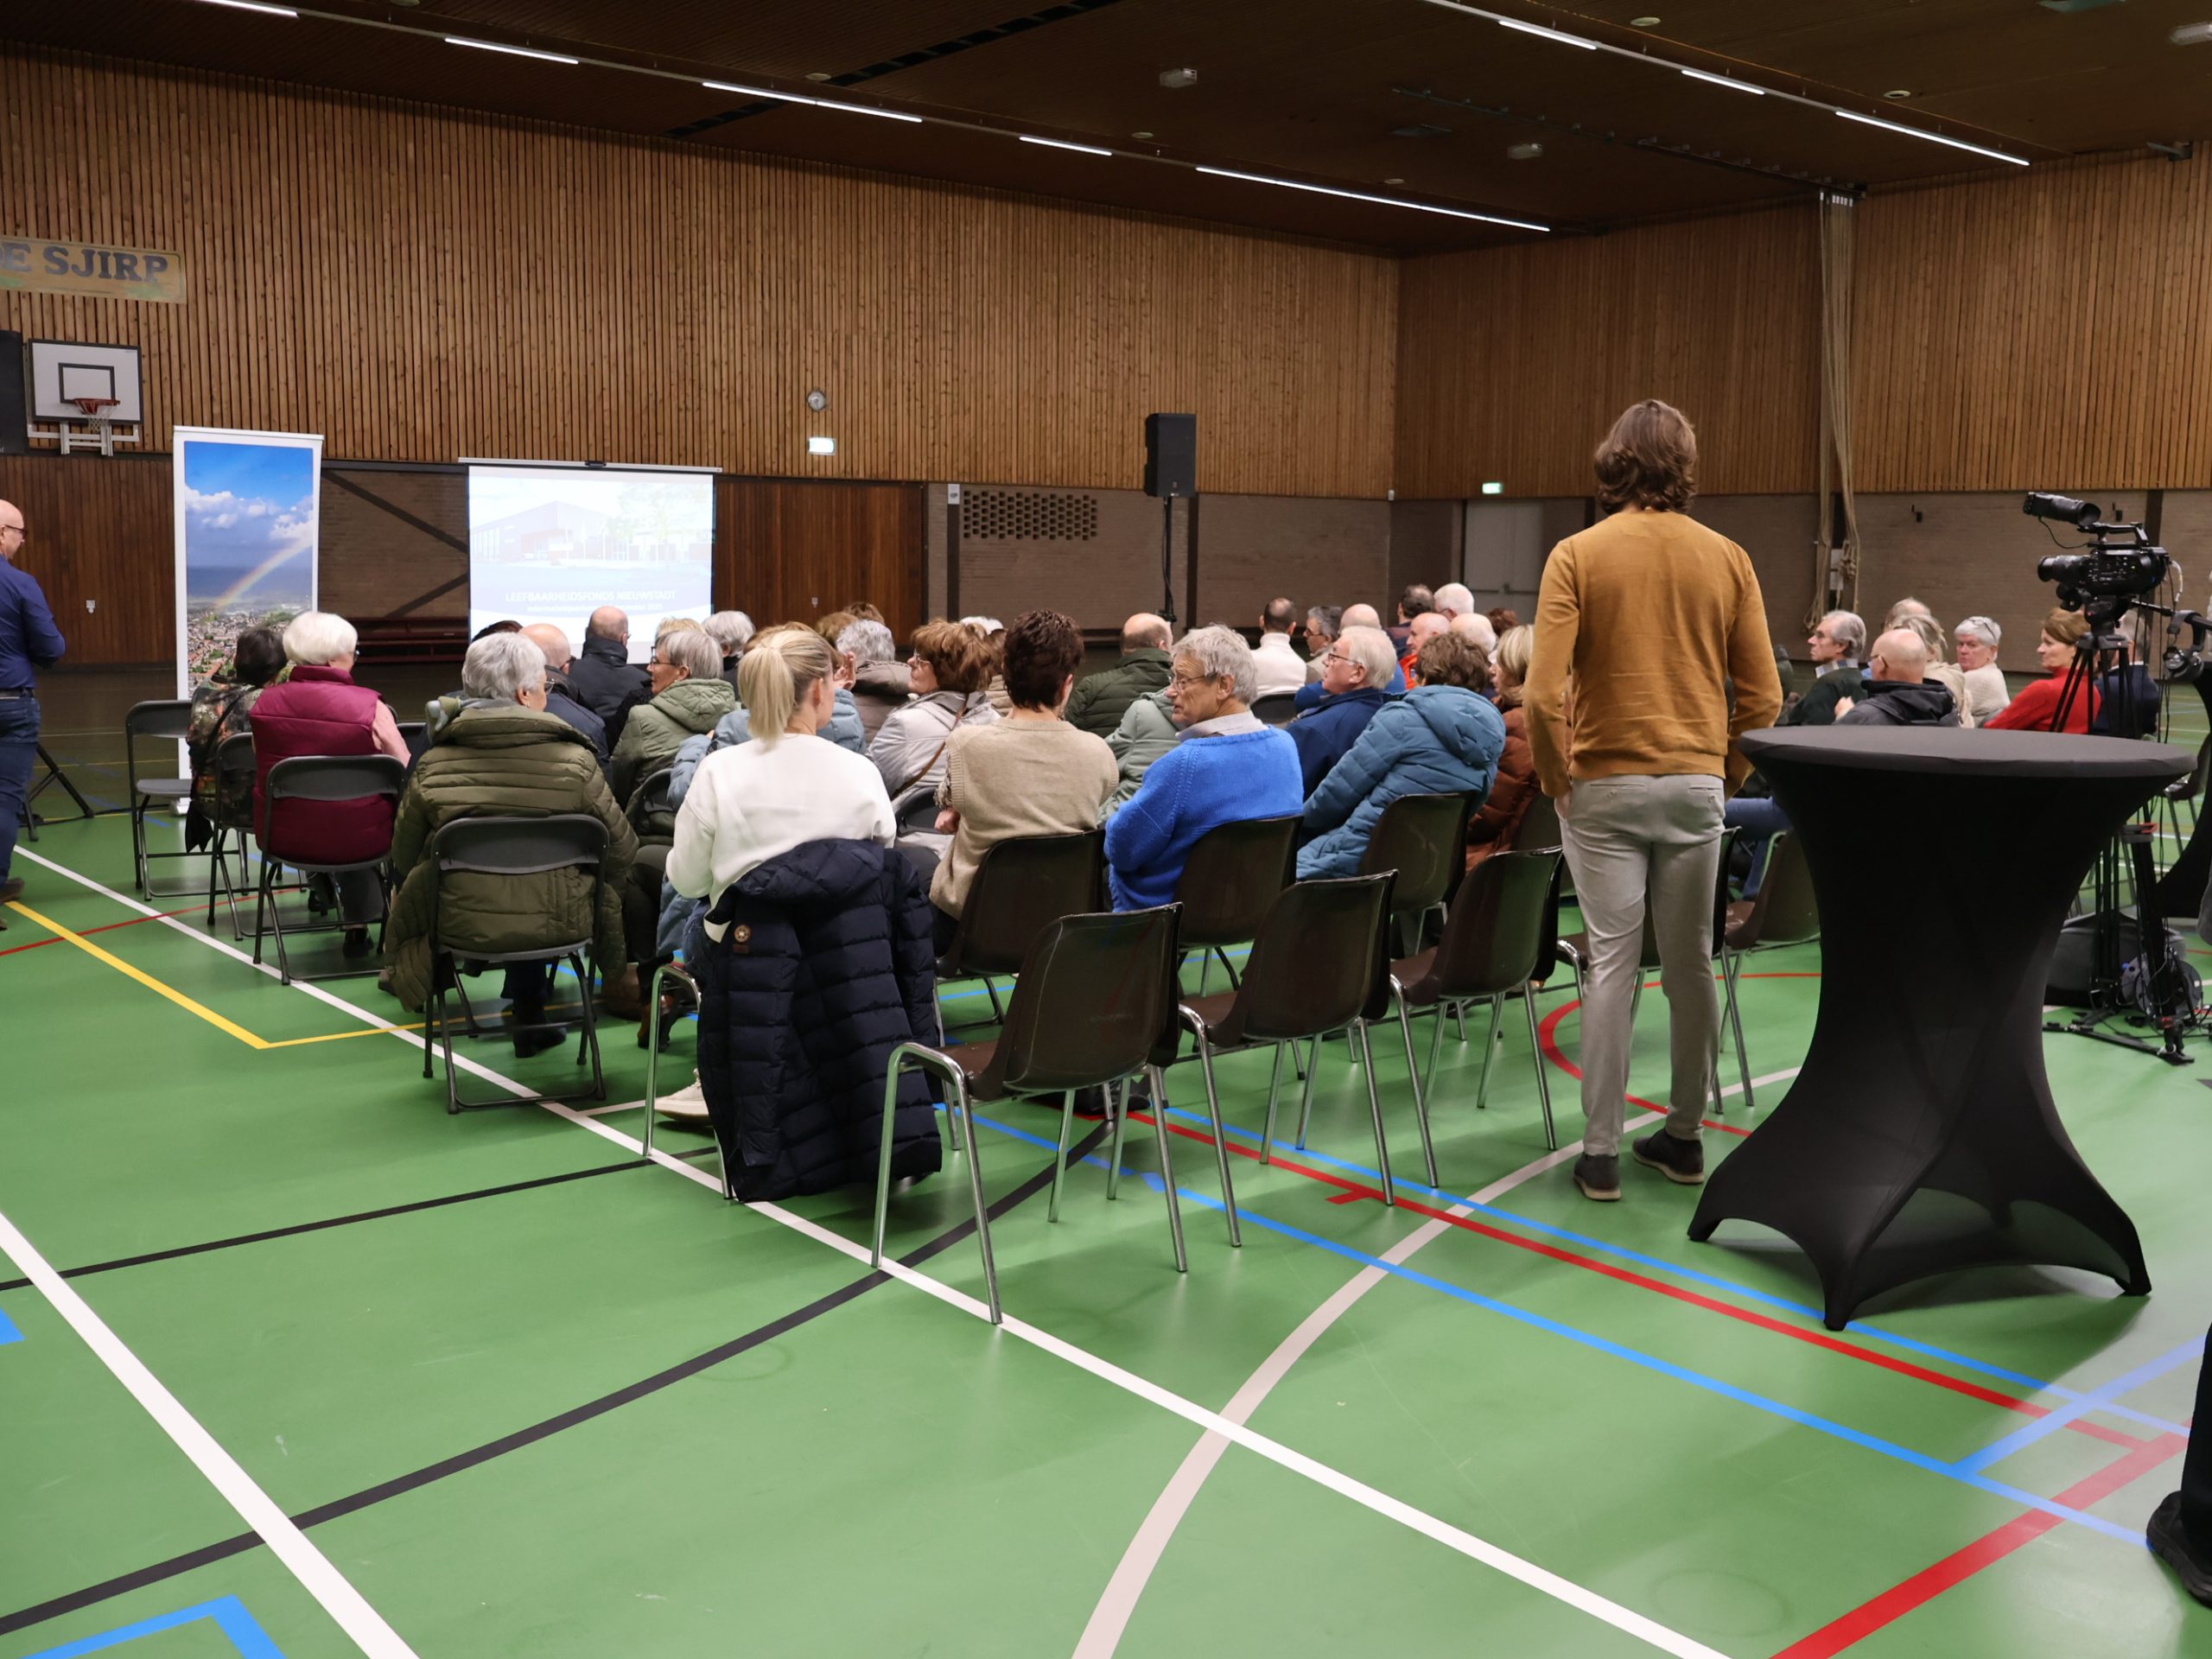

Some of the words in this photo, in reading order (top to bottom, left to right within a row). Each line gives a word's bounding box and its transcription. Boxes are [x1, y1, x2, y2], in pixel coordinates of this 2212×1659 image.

[0, 243, 32, 272] E
[43, 246, 168, 283] SJIRP
[505, 591, 614, 602] LEEFBAARHEIDSFONDS
[616, 590, 676, 601] NIEUWSTADT
